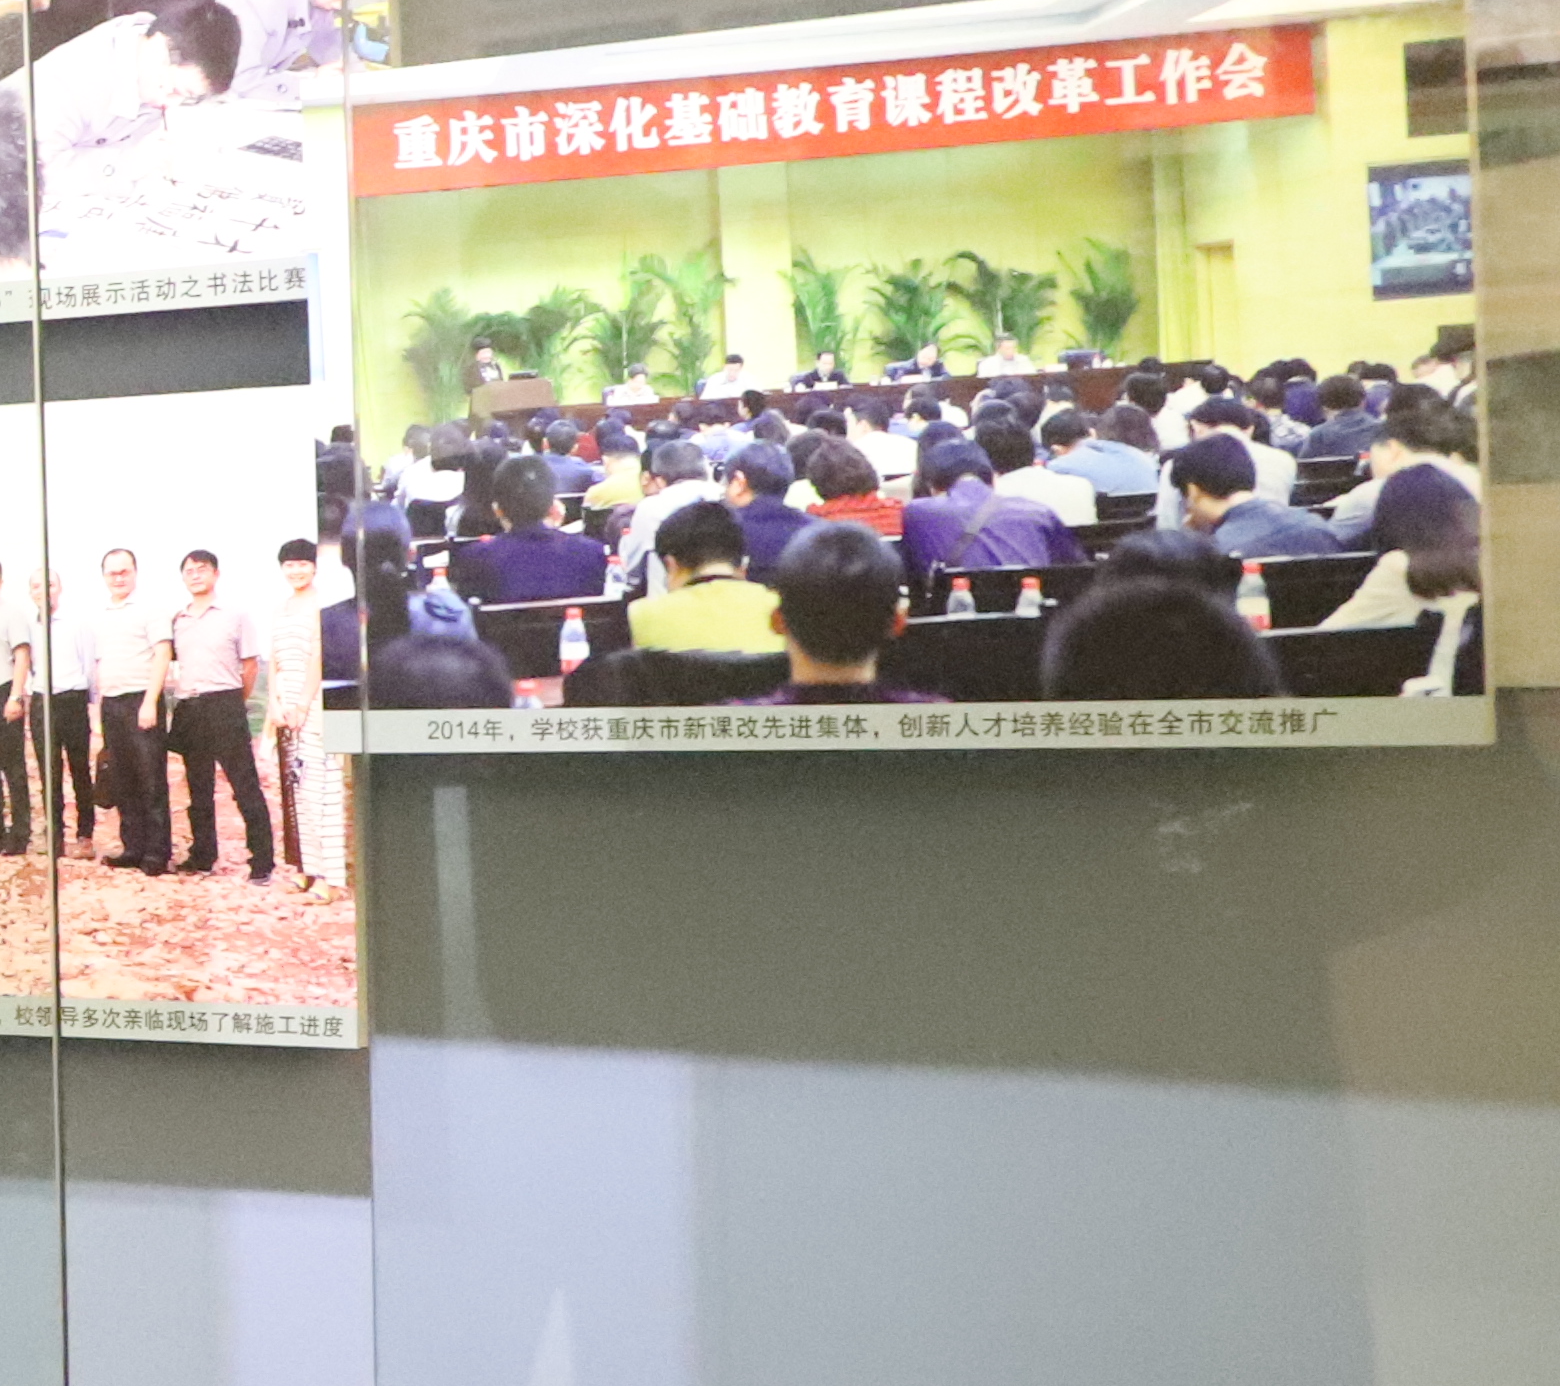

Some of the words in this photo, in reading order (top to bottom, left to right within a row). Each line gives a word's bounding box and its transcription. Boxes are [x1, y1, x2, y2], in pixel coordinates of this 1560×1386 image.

[393, 42, 1268, 169] 重庆市深化基础教育课程改革工作会
